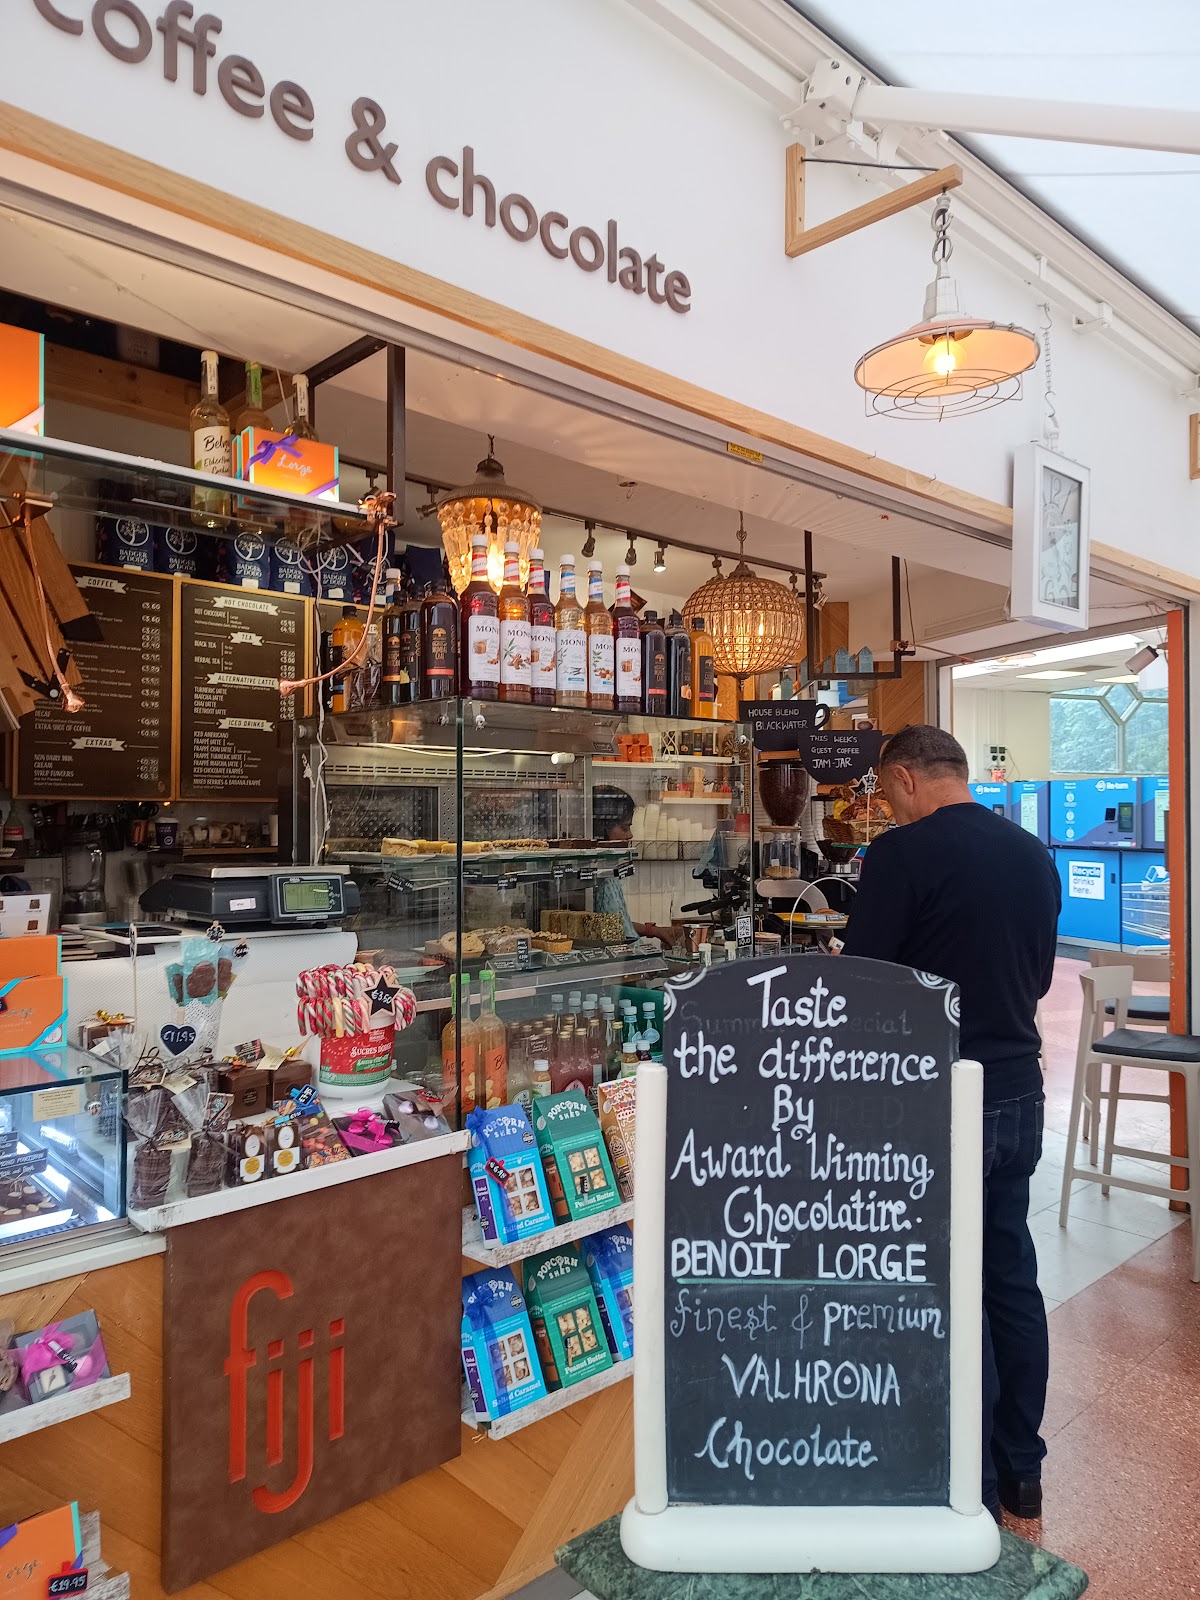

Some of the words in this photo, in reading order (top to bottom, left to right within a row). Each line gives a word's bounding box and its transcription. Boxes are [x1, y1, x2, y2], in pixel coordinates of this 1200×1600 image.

[345, 97, 401, 184] &
[425, 146, 691, 314] chocolate
[277, 454, 313, 476] Lorge
[87, 578, 114, 588] COFFEE
[237, 600, 270, 611] CHOCOLATE
[476, 625, 499, 634] MONI
[217, 675, 256, 685] ALTERNATIVE
[257, 678, 276, 686] LATTE
[748, 708, 773, 718] HOUSE
[775, 708, 800, 716] BLEND
[243, 720, 265, 728] DRINKS
[755, 719, 809, 731] BLACKWATER
[85, 739, 113, 747] EXTRAS
[811, 746, 832, 754] GUEST
[836, 747, 860, 755] COFFEE
[812, 757, 853, 769] JAM-JAR
[1072, 865, 1101, 878] Recycle
[1073, 876, 1095, 886] drinks
[1073, 886, 1092, 895] here.
[371, 989, 392, 1004] €3.50
[746, 965, 848, 1029] Taste
[673, 1030, 738, 1085] the
[758, 1035, 939, 1086] difference
[547, 1100, 588, 1121] POPCORN
[559, 1110, 581, 1121] SHED
[772, 1083, 814, 1141] By
[482, 1116, 526, 1138] POPCORN
[494, 1127, 518, 1138] SHED
[670, 1128, 792, 1187] Award
[806, 1132, 935, 1201] Winning
[574, 1196, 596, 1209] Penut
[596, 1190, 615, 1202] Butter
[524, 1213, 550, 1227] Caramel
[537, 1255, 579, 1280] POPCORN
[671, 1238, 790, 1278] BENOIT
[818, 1243, 927, 1282] LORGE
[549, 1266, 571, 1279] SHED
[670, 1288, 777, 1342] finest
[823, 1294, 945, 1346] premium
[565, 1361, 587, 1375] Peanut
[587, 1351, 607, 1366] Butter
[721, 1352, 901, 1407] VALHRONA
[223, 1269, 345, 1514] fiji
[514, 1380, 541, 1399] Caramel
[694, 1416, 878, 1480] Chocolate
[5, 1559, 39, 1580] orge
[48, 1574, 87, 1593] €19.95
